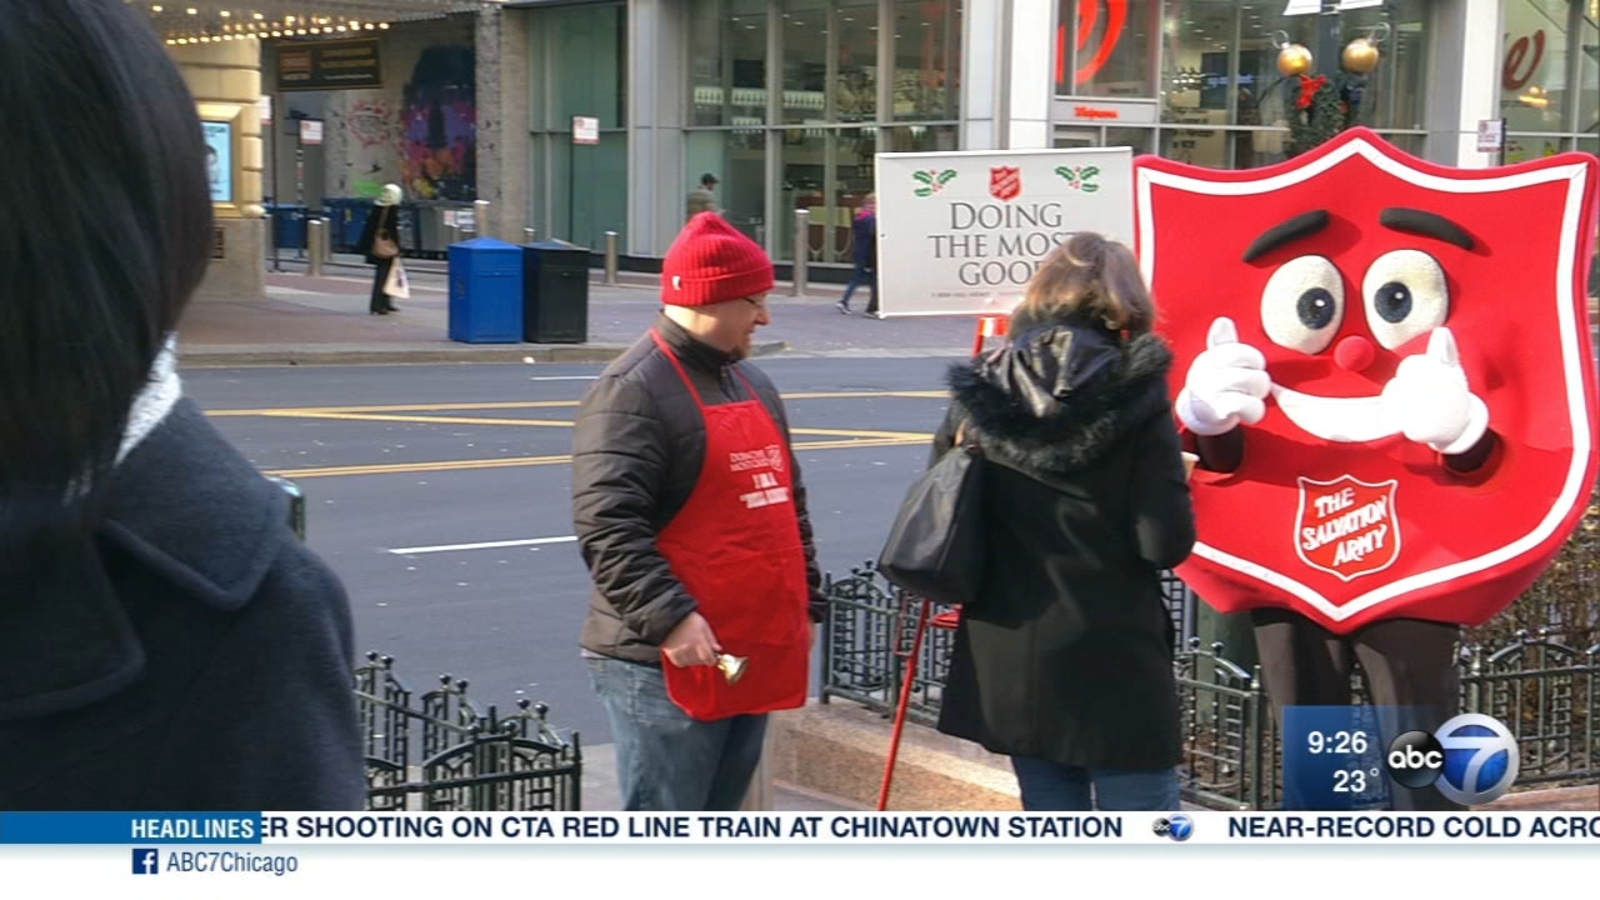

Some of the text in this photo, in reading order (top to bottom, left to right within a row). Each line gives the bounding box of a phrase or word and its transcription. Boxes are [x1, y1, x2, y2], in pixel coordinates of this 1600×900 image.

[950, 202, 1063, 230] DOING
[927, 231, 1079, 259] THE MOS
[958, 260, 1044, 286] GOO
[1314, 486, 1356, 519] THE
[1302, 494, 1388, 551] SALVATION
[1332, 523, 1388, 567] ARMY
